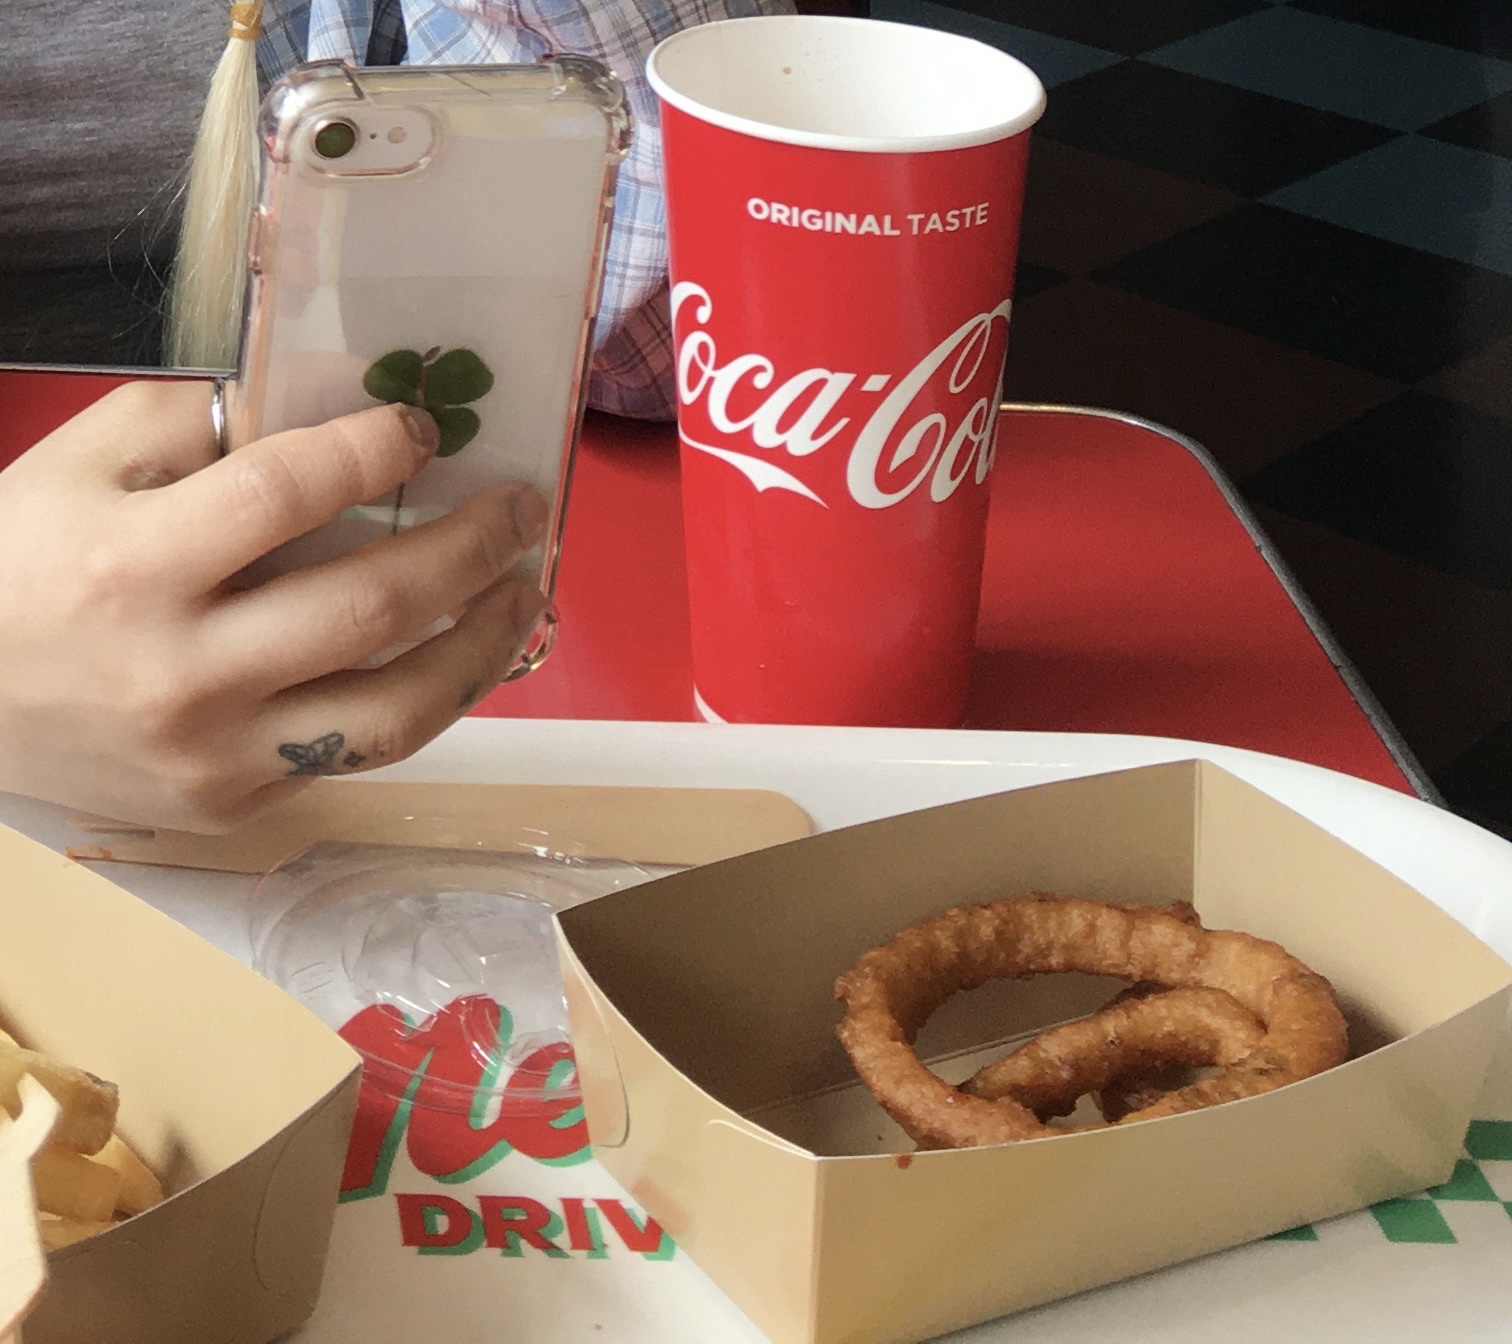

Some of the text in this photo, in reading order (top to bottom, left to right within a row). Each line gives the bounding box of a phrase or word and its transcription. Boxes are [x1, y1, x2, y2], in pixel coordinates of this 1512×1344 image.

[746, 196, 990, 238] ORIGINAL TASTE
[395, 1192, 676, 1262] DRIV
